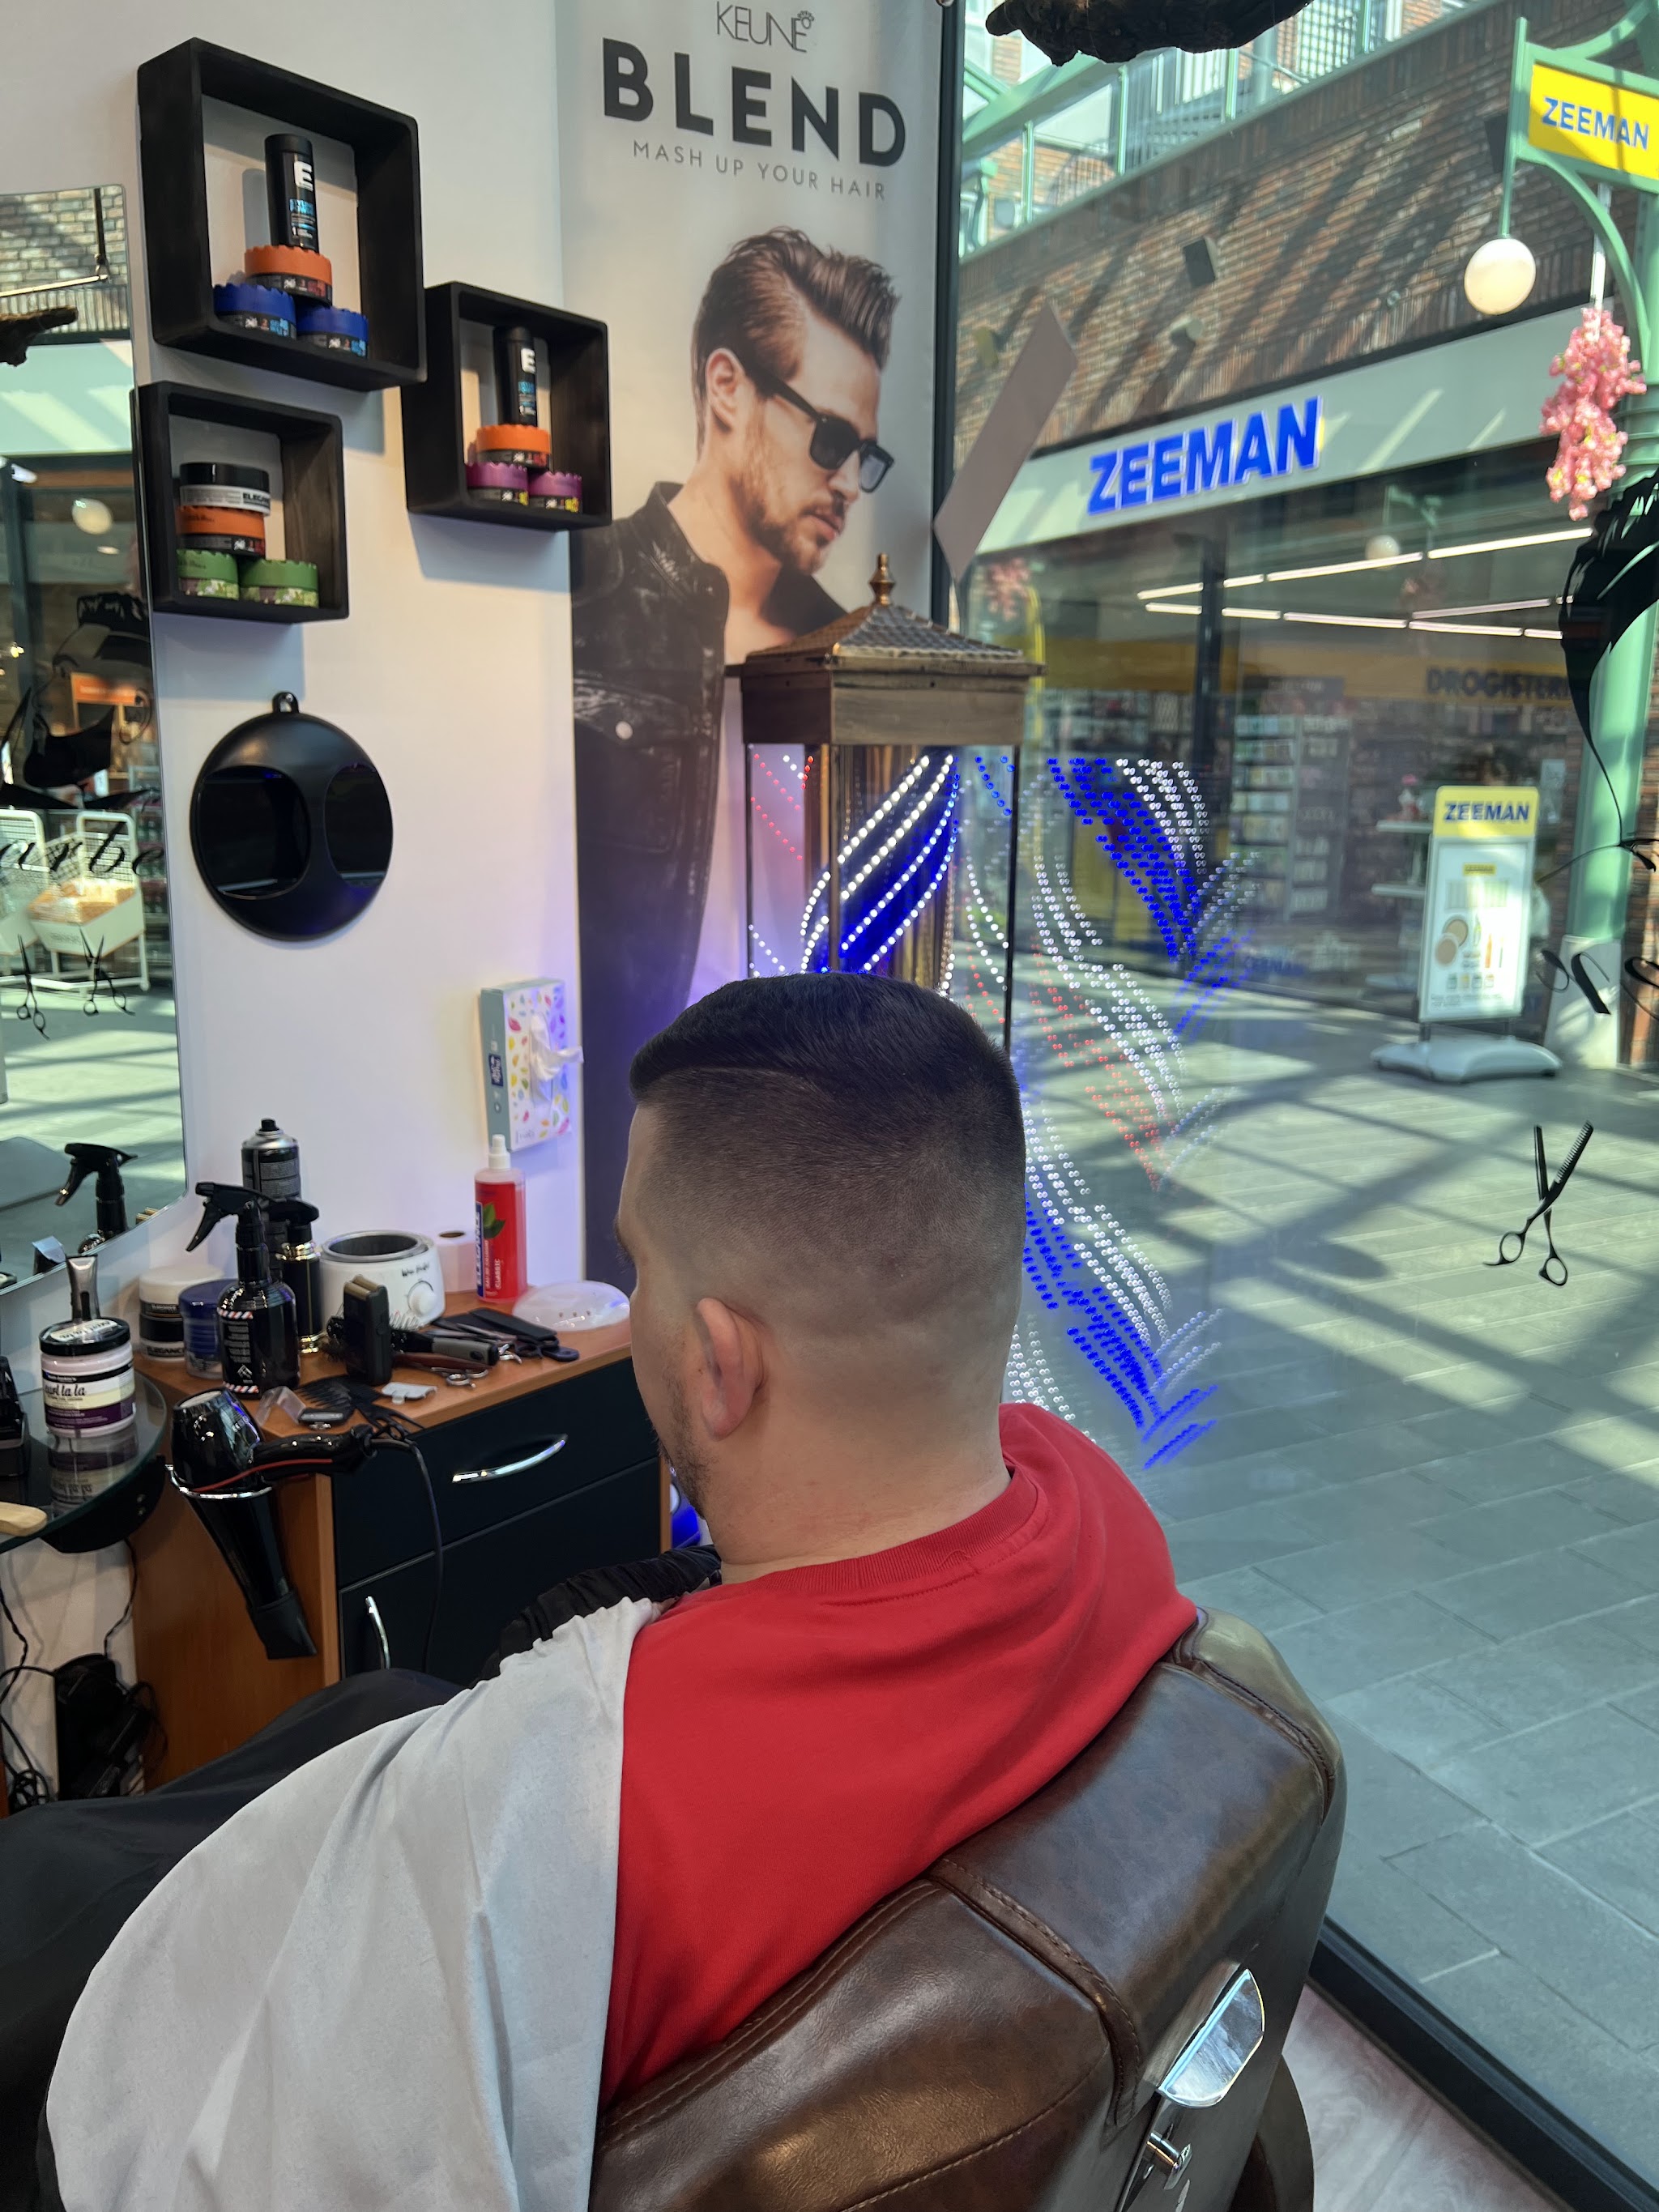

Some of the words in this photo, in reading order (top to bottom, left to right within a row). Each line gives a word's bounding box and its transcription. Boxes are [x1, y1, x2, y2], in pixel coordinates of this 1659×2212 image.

[717, 1, 807, 53] KEUNE
[603, 37, 906, 167] BLEND
[1542, 96, 1649, 151] ZEEMAN
[633, 139, 702, 167] MASH
[716, 154, 744, 176] UP
[757, 163, 818, 190] YOUR
[831, 176, 885, 201] HAIR
[1087, 395, 1323, 516] ZEEMAN
[1444, 801, 1530, 822] ZEEMAN
